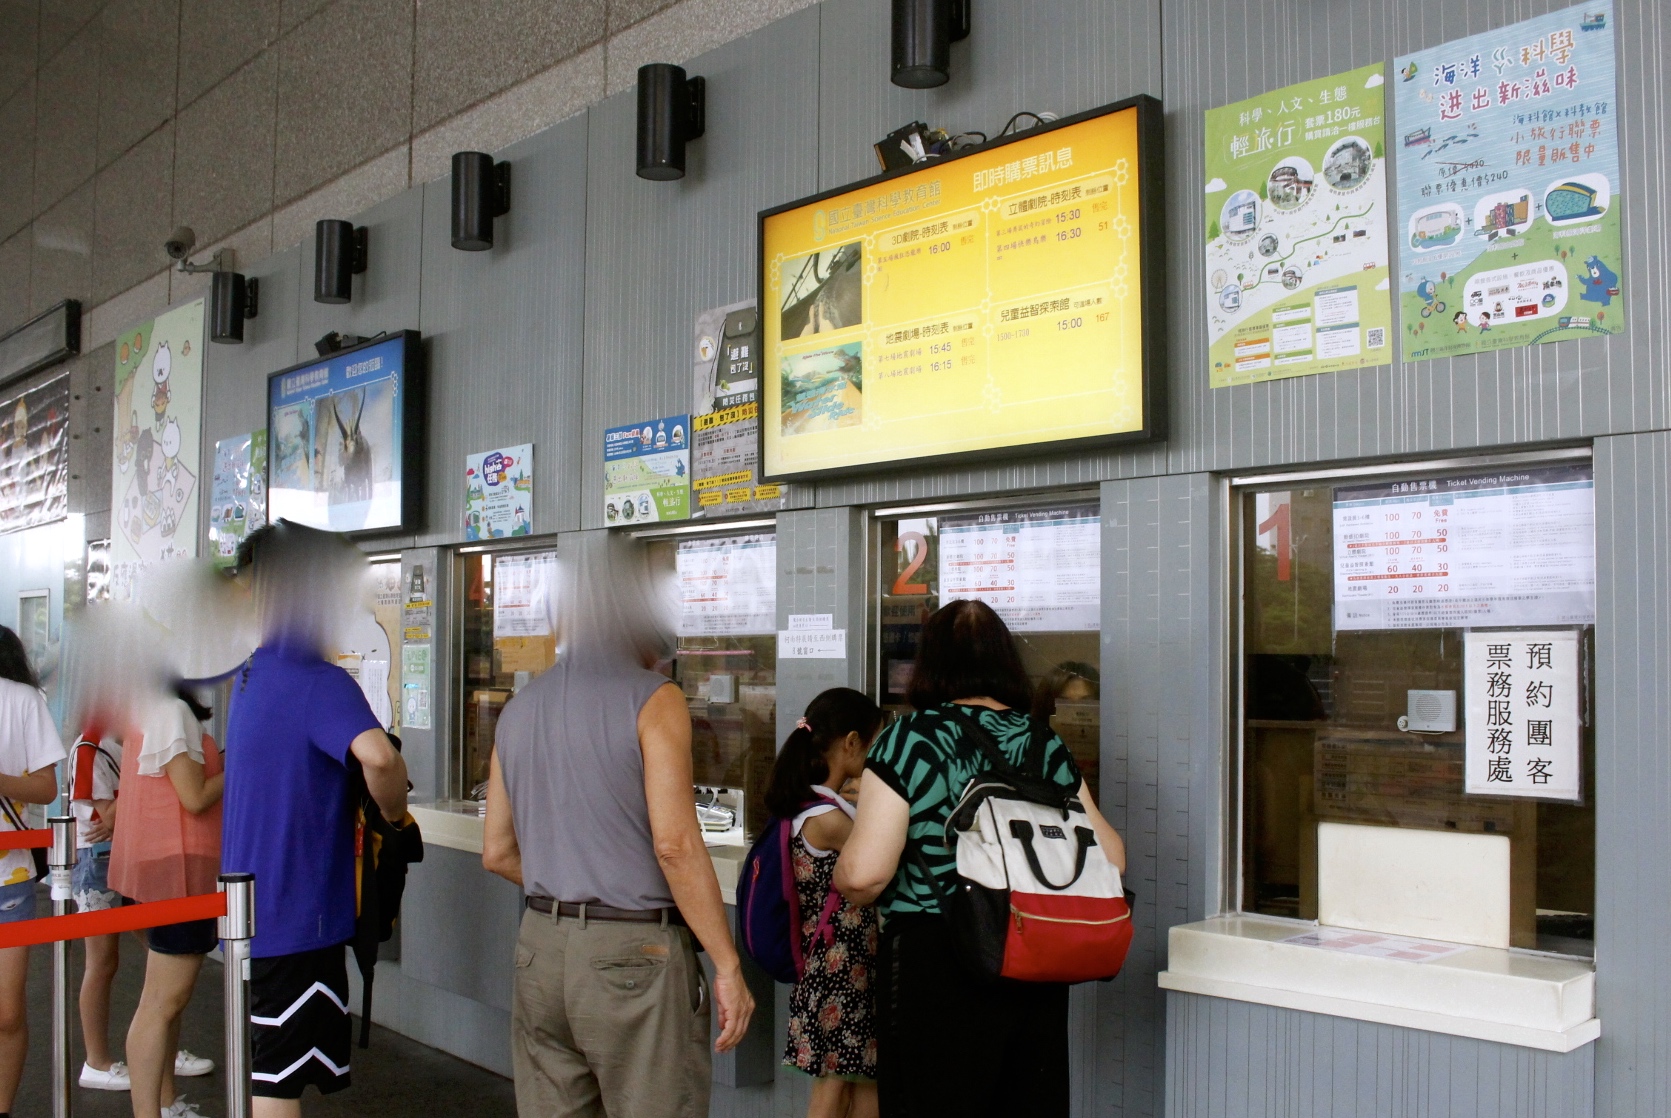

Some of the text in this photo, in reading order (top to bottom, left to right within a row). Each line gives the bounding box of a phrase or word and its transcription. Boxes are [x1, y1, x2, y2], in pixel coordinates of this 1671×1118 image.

[1239, 85, 1347, 127] 科學、人文、生態
[1305, 106, 1361, 129] 套票180元
[1230, 120, 1296, 160] 輕旅行
[1516, 141, 1595, 166] 限量販售中
[973, 147, 1073, 192] 即時購票訊息
[828, 180, 942, 226] 國立臺灣科學教育館
[1008, 186, 1082, 216] 立體劇院-時刻表
[1055, 208, 1081, 224] 15:30
[891, 221, 949, 246] 3D劇院-時刻表
[1056, 227, 1082, 242] 16:30
[1098, 221, 1108, 231] 51
[1000, 298, 1070, 322] 兒童益智探索館
[1057, 317, 1083, 331] 15:00
[1096, 312, 1110, 323] 167
[886, 321, 949, 345] 地震劇場-時刻表
[930, 342, 952, 355] 15:45
[930, 359, 952, 372] 16:15
[1392, 474, 1529, 493] 自動售票機 Ticket Vending Machine
[1385, 513, 1400, 521] 100
[1258, 503, 1290, 581] 1
[1385, 531, 1400, 540] 100
[1411, 530, 1422, 538] 70
[1437, 528, 1448, 537] 50
[1385, 547, 1400, 555] 100
[1411, 546, 1422, 554] 70
[1437, 545, 1448, 553] 50
[892, 531, 927, 594] 2
[1387, 565, 1398, 573] 60
[1412, 564, 1422, 572] 40
[1438, 563, 1448, 571] 30
[1388, 586, 1399, 594] 20
[1413, 585, 1423, 593] 20
[1438, 584, 1449, 592] 20
[1486, 642, 1513, 784] 票務服務處
[1525, 642, 1553, 785] 預約團客
